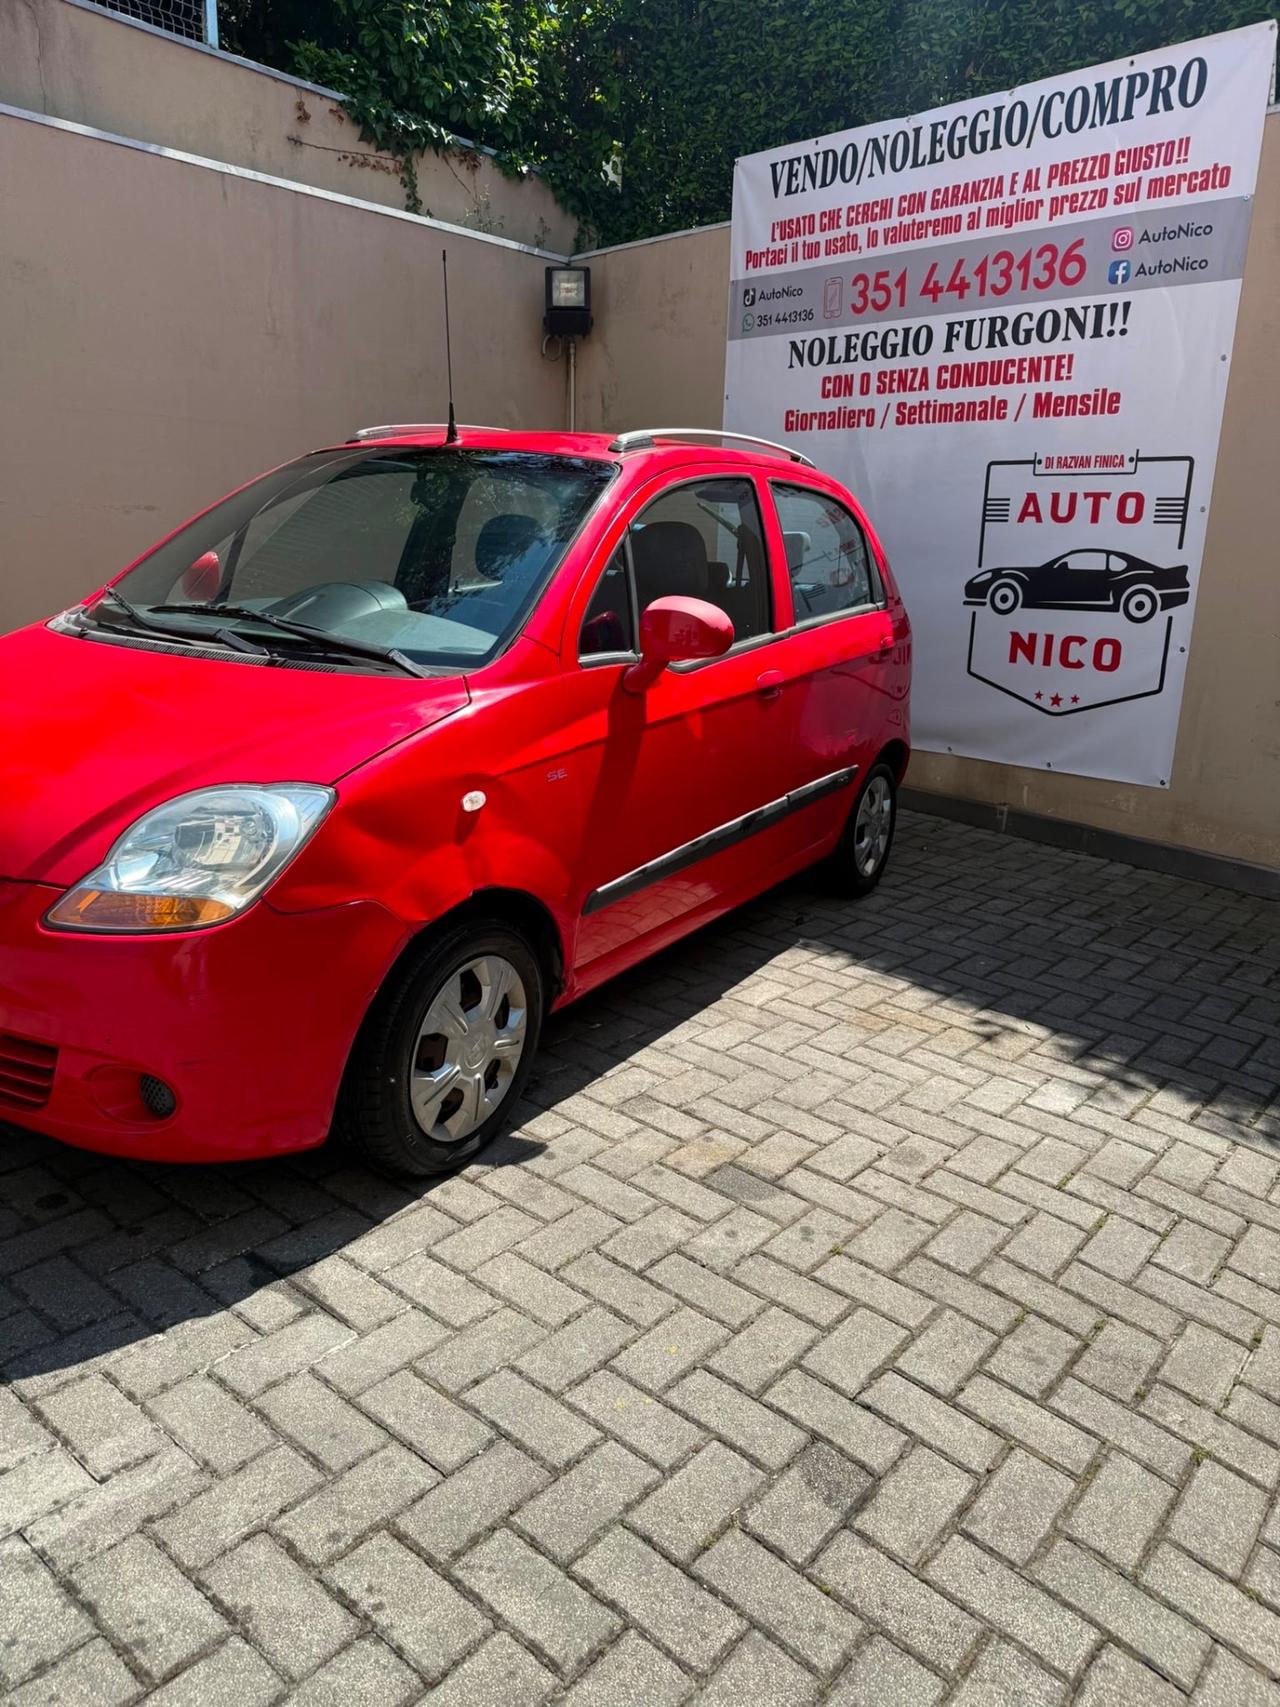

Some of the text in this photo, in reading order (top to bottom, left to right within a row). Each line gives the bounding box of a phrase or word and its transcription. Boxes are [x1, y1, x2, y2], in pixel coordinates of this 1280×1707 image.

[770, 56, 1208, 198] VENDO/NOLEGGIO/COMPRO
[771, 136, 1191, 242] L'USATO CHE CERCHI CON GARANZIA E AL PREZZO GIUSTO!!
[746, 162, 1232, 271] Portaci il tuo usato, lo valuteremo al miglior prezzo sul mercato
[1138, 222, 1213, 245] AutoNico
[851, 238, 1087, 314] 351 4413136
[1135, 257, 1209, 278] AutoNico
[758, 287, 803, 302] AutoNico
[757, 308, 814, 327] 351 4413136
[788, 301, 1132, 369] NOLEGGIO FURGONI!!
[821, 353, 1074, 399] CON O SENZA CONDUCENTE!
[784, 388, 1121, 432] Giornaliero / Settimanale / Mensile
[1044, 454, 1125, 469] DI RAZVAN FINICA
[1016, 491, 1146, 524] AUTO
[1008, 631, 1122, 672] NICO
[547, 768, 568, 782] SE
